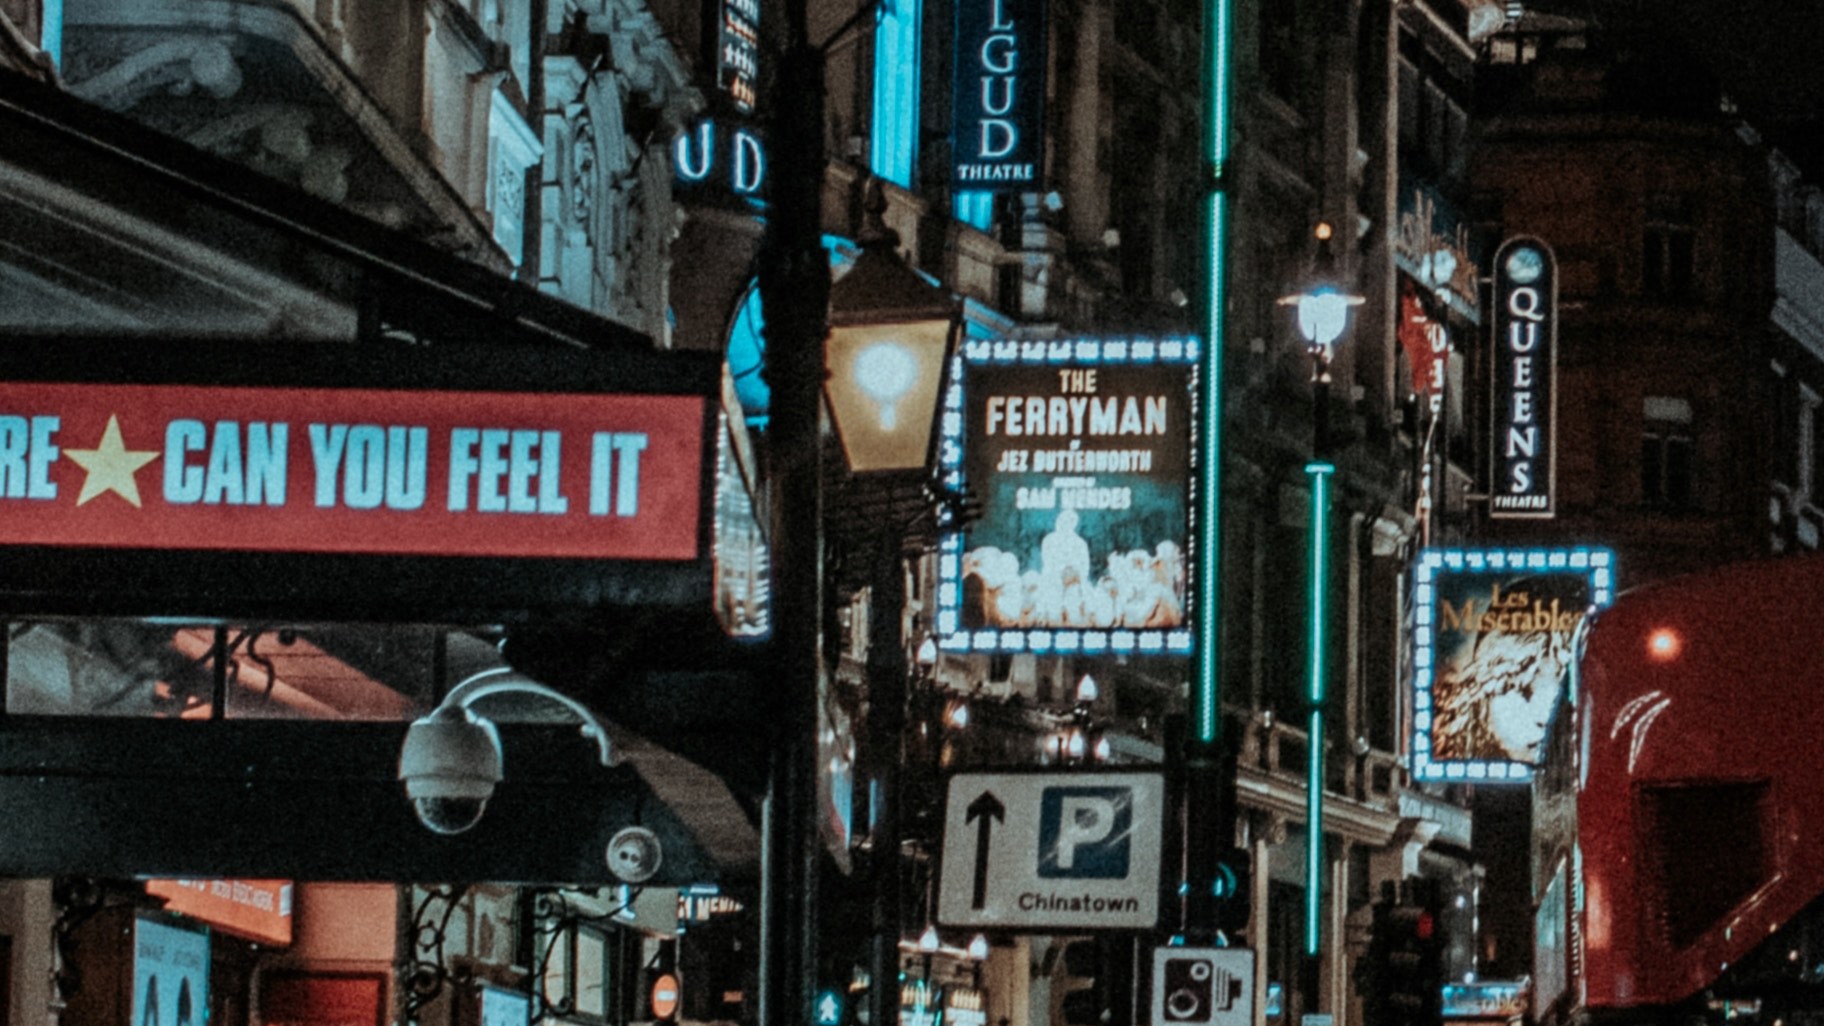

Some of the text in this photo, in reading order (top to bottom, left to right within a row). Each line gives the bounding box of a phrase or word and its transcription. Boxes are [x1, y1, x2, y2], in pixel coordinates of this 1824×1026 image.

[958, 164, 1034, 180] THEATRE
[1059, 369, 1097, 393] THE
[1506, 287, 1545, 493] QUEENS
[986, 396, 1167, 435] FERRYMAN
[163, 419, 288, 506] CAN
[308, 423, 428, 510] YOU
[448, 427, 569, 514] FEEL
[589, 431, 648, 517] IT
[997, 451, 1029, 472] JEZ
[1495, 496, 1548, 508] THEATRE
[1491, 583, 1529, 607] Les
[1057, 796, 1115, 869] P
[1018, 892, 1139, 912] Chinatown
